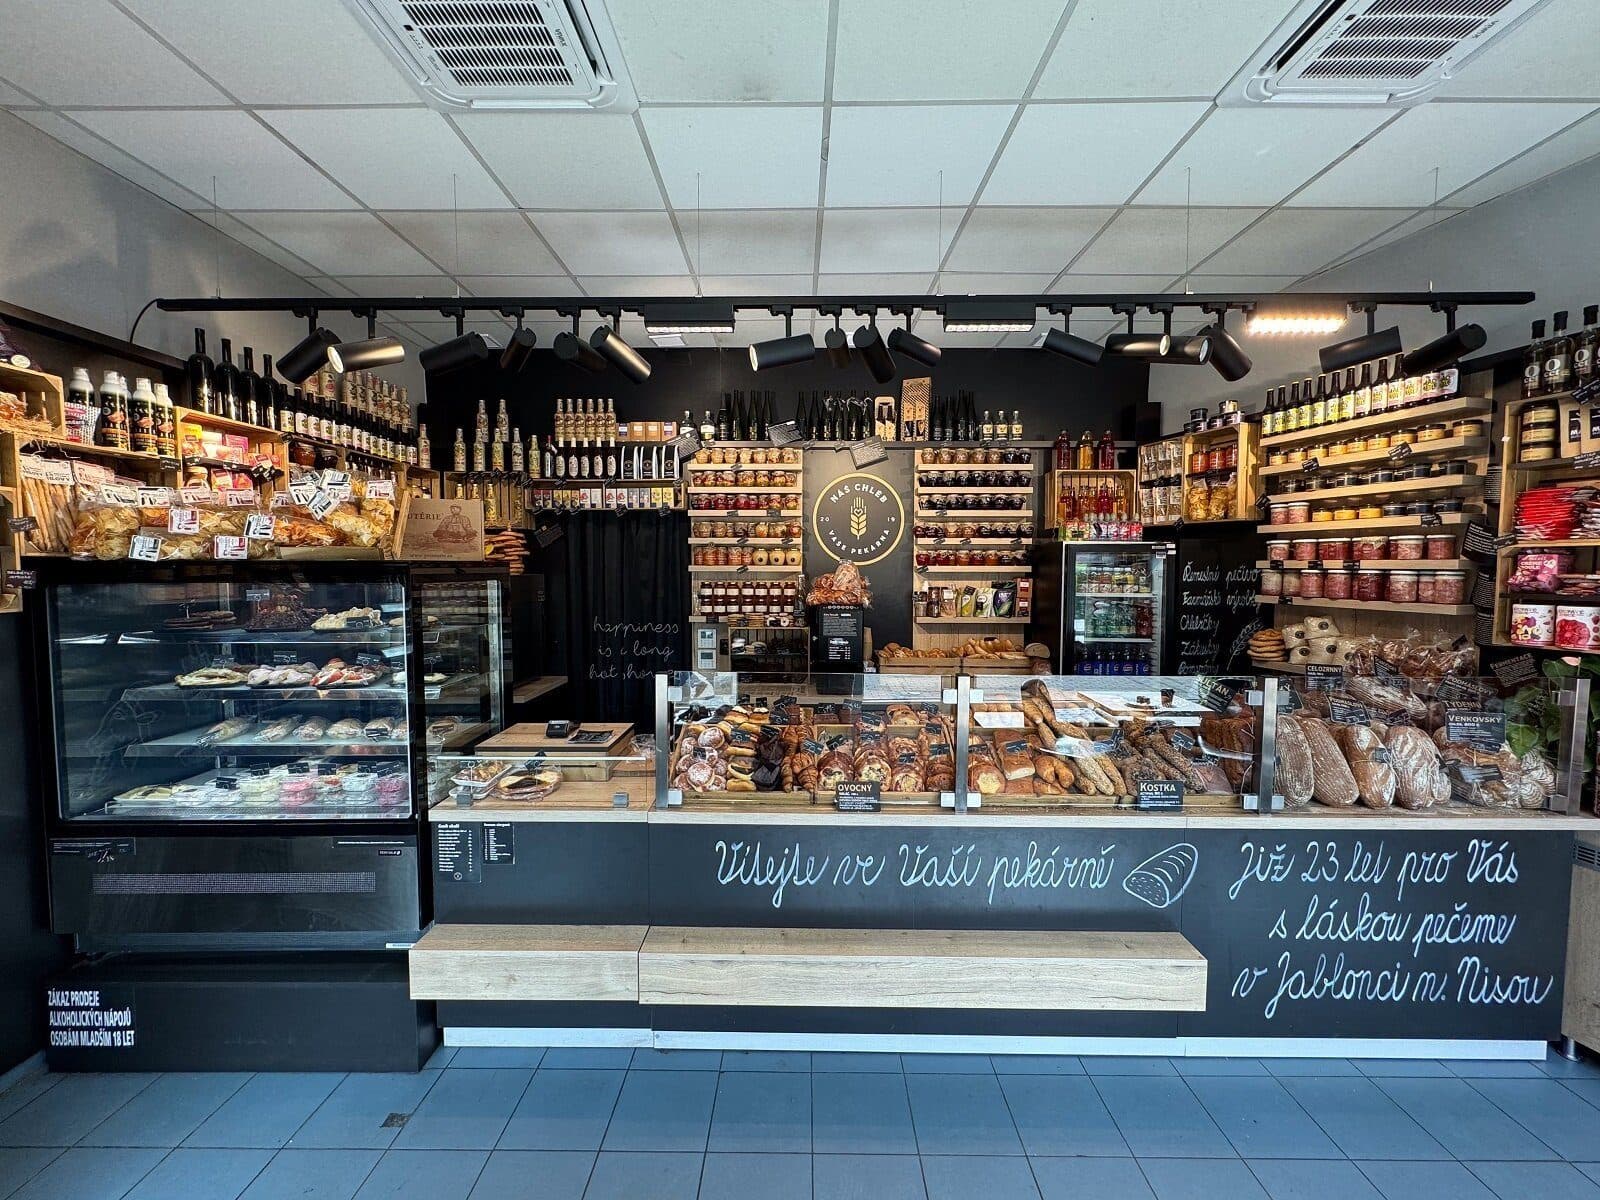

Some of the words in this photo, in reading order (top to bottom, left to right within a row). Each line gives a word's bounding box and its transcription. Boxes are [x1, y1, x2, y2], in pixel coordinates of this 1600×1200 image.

[593, 615, 679, 638] happiness
[598, 645, 612, 657] is
[633, 640, 674, 662] long
[589, 663, 618, 679] hot
[1140, 782, 1176, 792] KOSTKA
[715, 840, 829, 908] Vítejte
[833, 850, 887, 888] ve
[899, 841, 983, 889] Vaší
[987, 841, 1117, 905] pekárně
[1228, 841, 1295, 900] Již
[1301, 840, 1340, 883] 23
[1344, 840, 1391, 884] let
[1397, 849, 1458, 902] pro
[1465, 838, 1520, 884] Vás
[1268, 908, 1287, 940] s
[1295, 891, 1412, 943] láskou
[1412, 902, 1517, 958] pečeme
[1231, 965, 1268, 999] v
[1264, 951, 1411, 1019] Jablonci
[1412, 973, 1448, 1002] n.
[1457, 955, 1554, 1005] Nisou
[48, 987, 69, 1006] ZÁKAZ
[70, 990, 99, 1006] PRODEJE
[49, 1008, 102, 1026] ALKOHOLICKÝCH
[103, 1006, 132, 1026] NÁPOJŮ
[50, 1028, 79, 1046] OSOBÁM
[80, 1028, 111, 1046] MLADŠÍM
[112, 1031, 121, 1046] 18
[122, 1030, 134, 1046] LET
